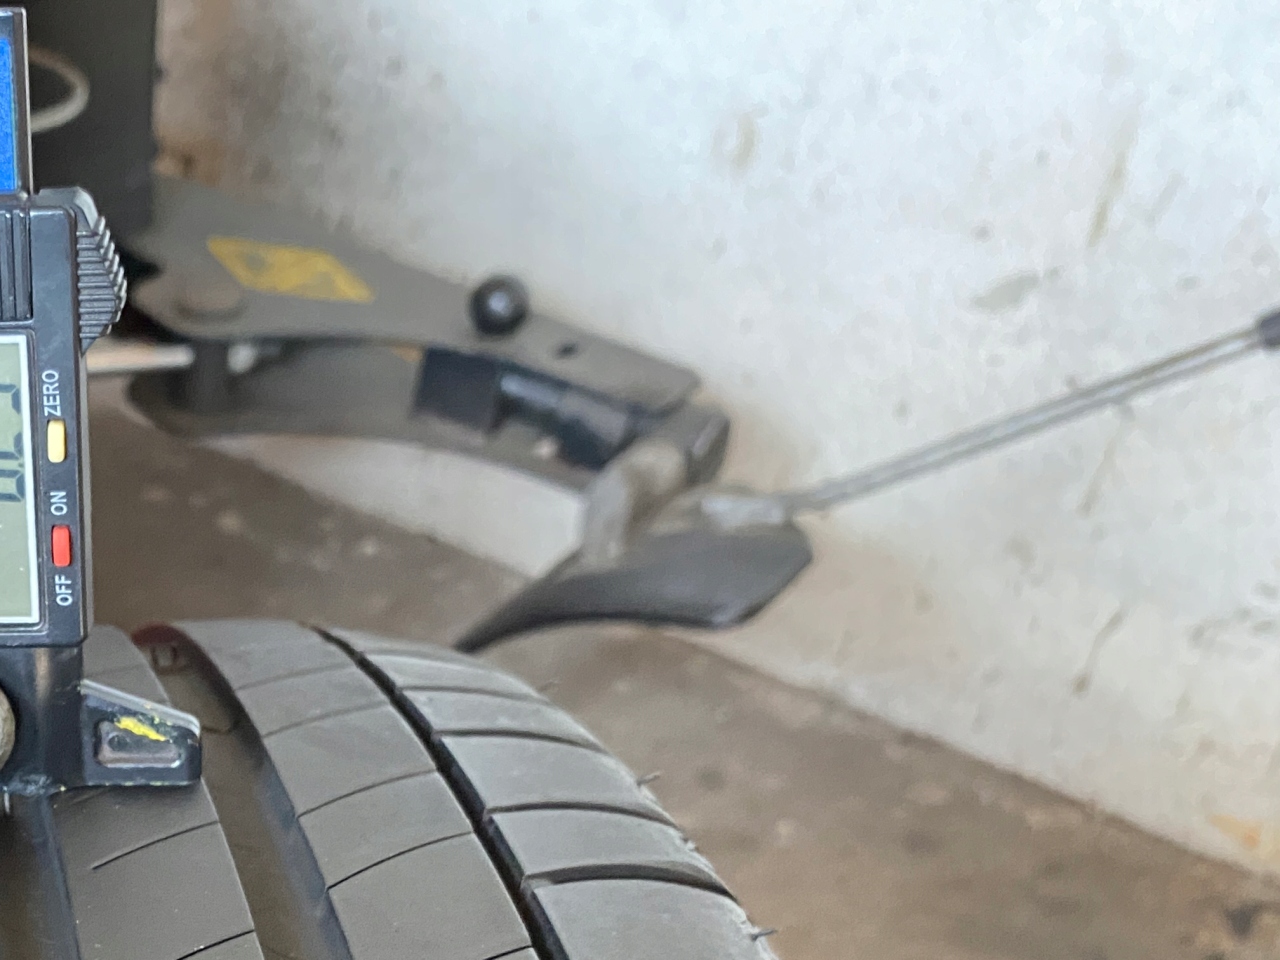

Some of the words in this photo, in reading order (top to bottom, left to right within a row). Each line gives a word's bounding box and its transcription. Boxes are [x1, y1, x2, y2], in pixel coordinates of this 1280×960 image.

[41, 370, 62, 417] ZERO
[51, 490, 67, 516] ON
[56, 575, 73, 607] OFF
